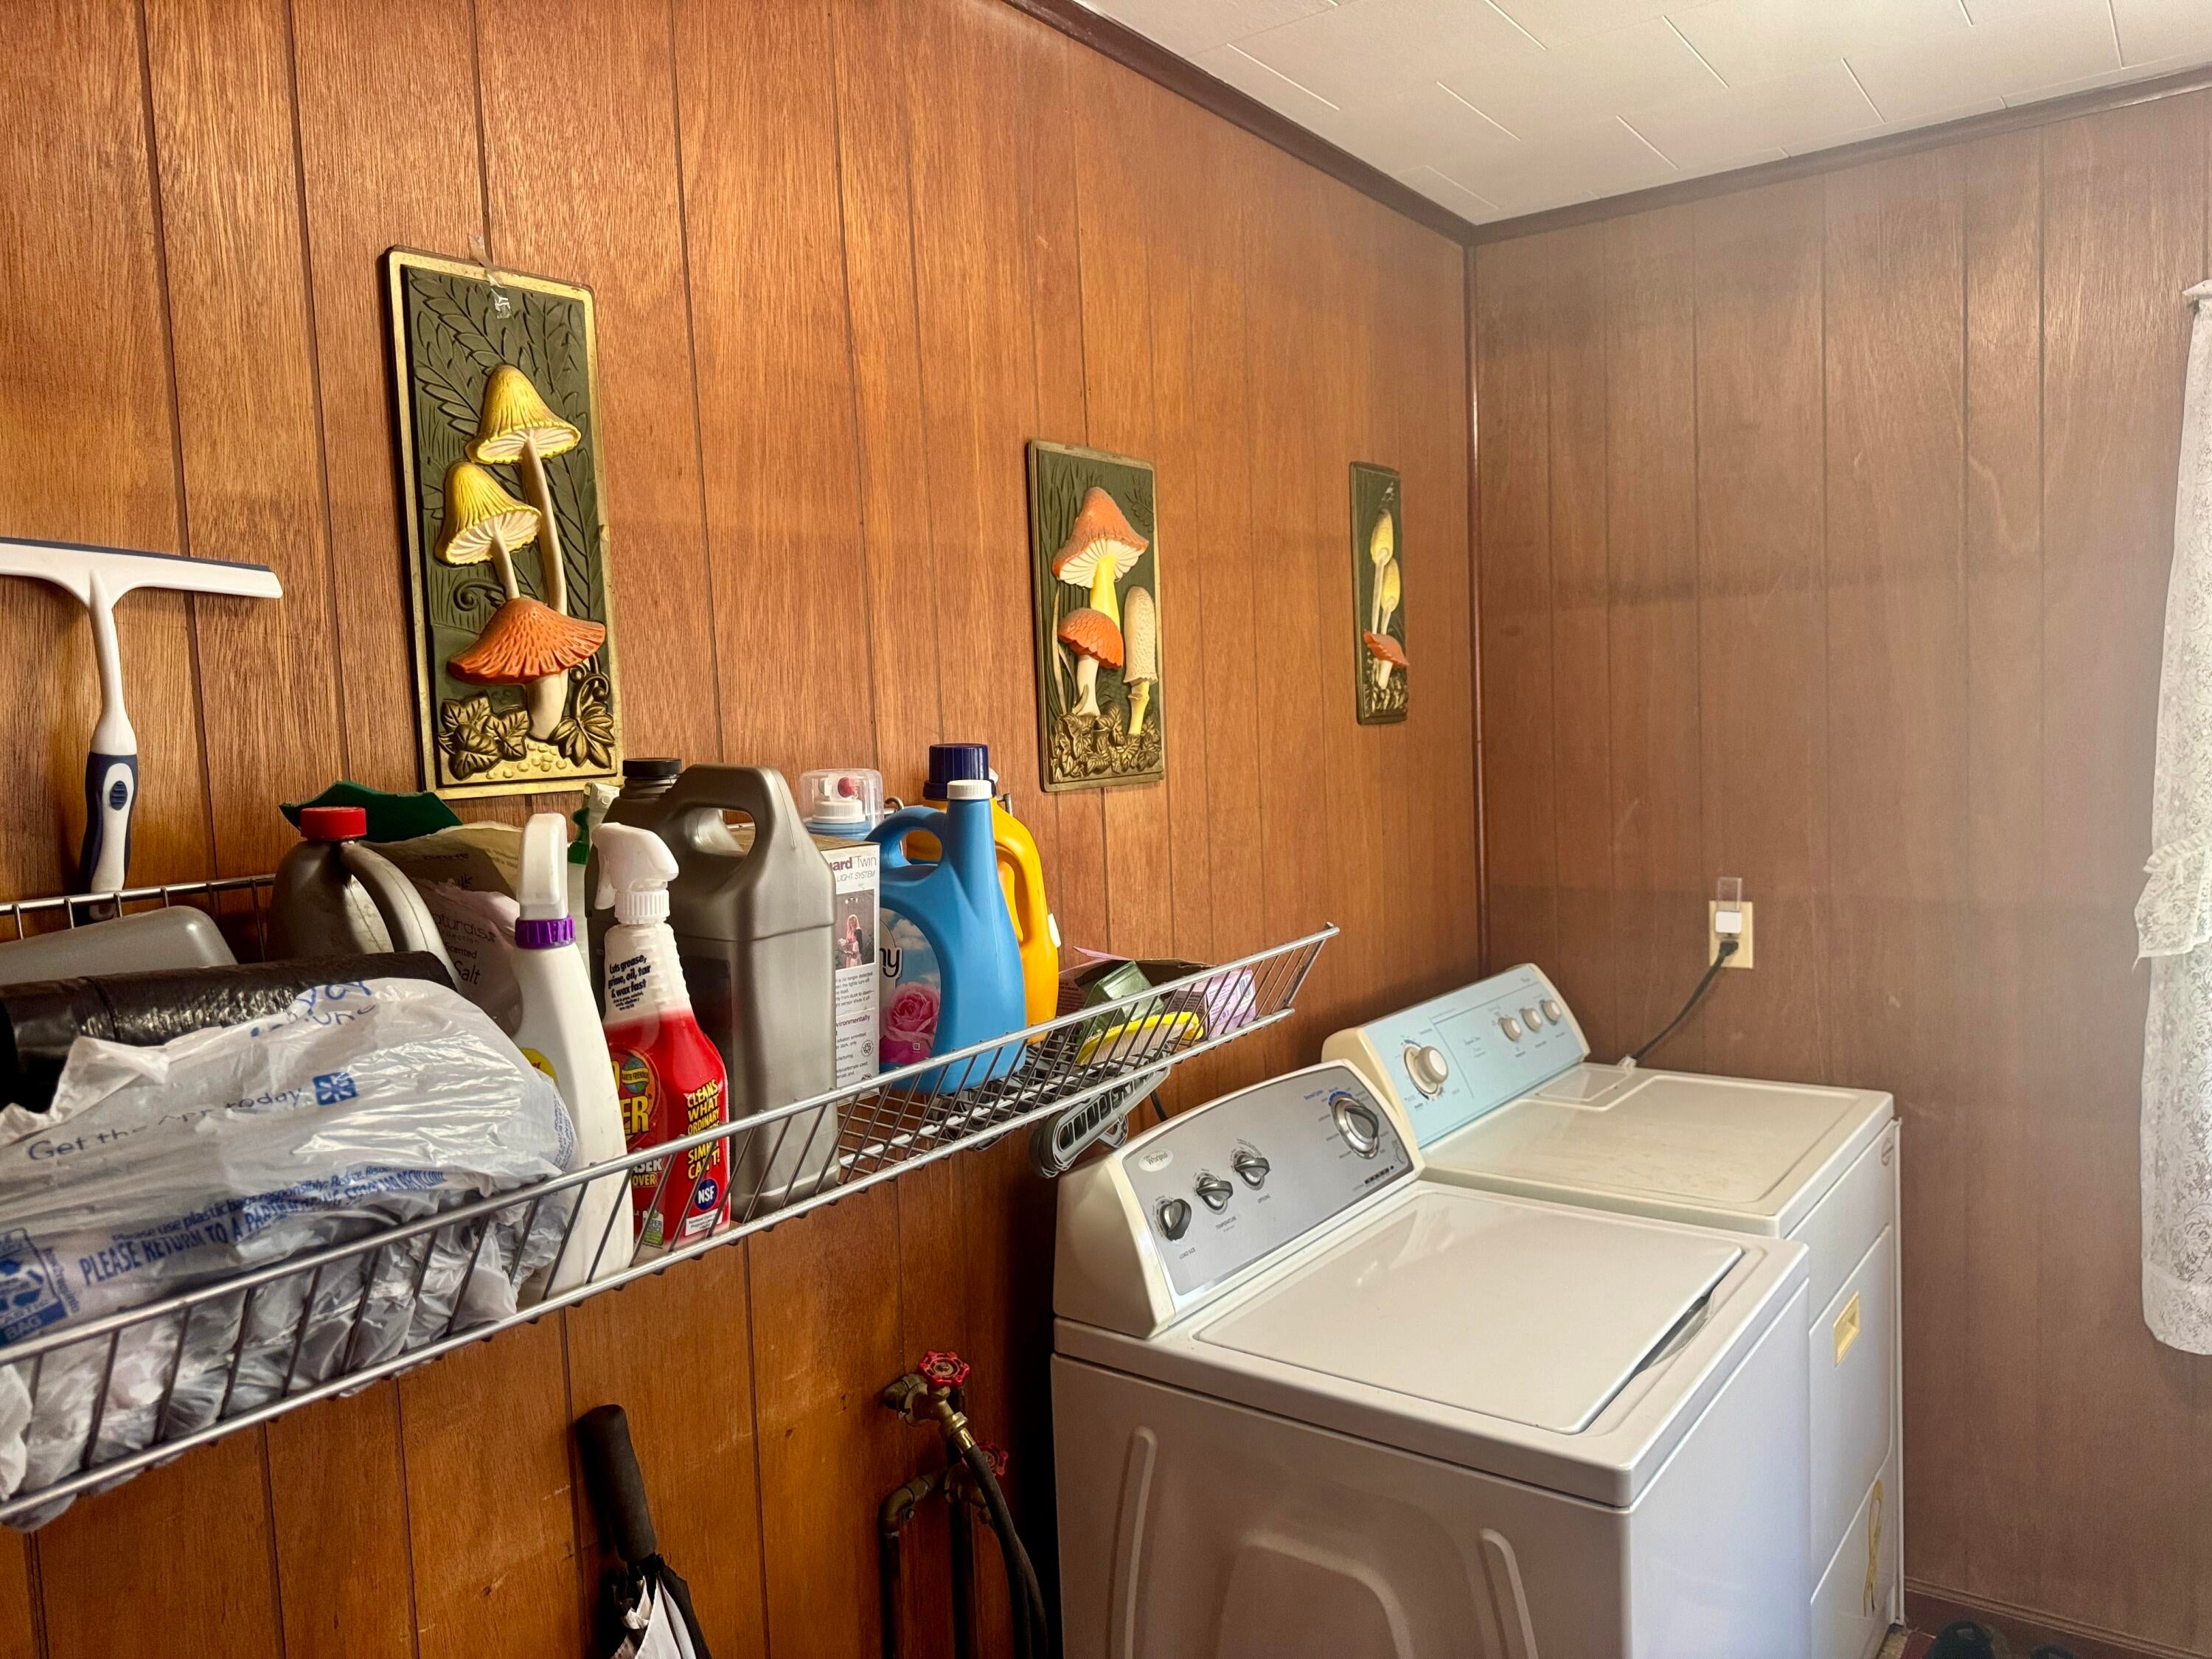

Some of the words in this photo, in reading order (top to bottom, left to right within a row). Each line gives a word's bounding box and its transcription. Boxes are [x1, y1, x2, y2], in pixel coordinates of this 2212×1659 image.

[855, 855, 877, 868] Twin
[837, 872, 853, 882] LIGHT
[855, 869, 876, 880] SYSTEM
[453, 960, 481, 985] Salt
[620, 955, 647, 972] grease,
[608, 975, 625, 989] grime,
[626, 967, 638, 980] oil,
[638, 964, 651, 976] tar
[616, 986, 630, 997] wax
[630, 978, 647, 992] fast
[687, 1079, 719, 1108] CLEANS
[688, 1094, 719, 1122] WHAT
[28, 1140, 87, 1161] Get
[225, 1088, 302, 1108] today
[687, 1107, 720, 1135] ORDINARY
[688, 1147, 720, 1179] CAT!
[632, 1173, 656, 1186] OVER
[698, 1185, 714, 1204] NSF
[158, 1219, 182, 1234] use
[184, 1204, 224, 1230] plastic
[79, 1240, 142, 1286] PLEASE
[141, 1229, 207, 1264] RETURN
[205, 1222, 229, 1245] TO
[231, 1215, 244, 1242] A
